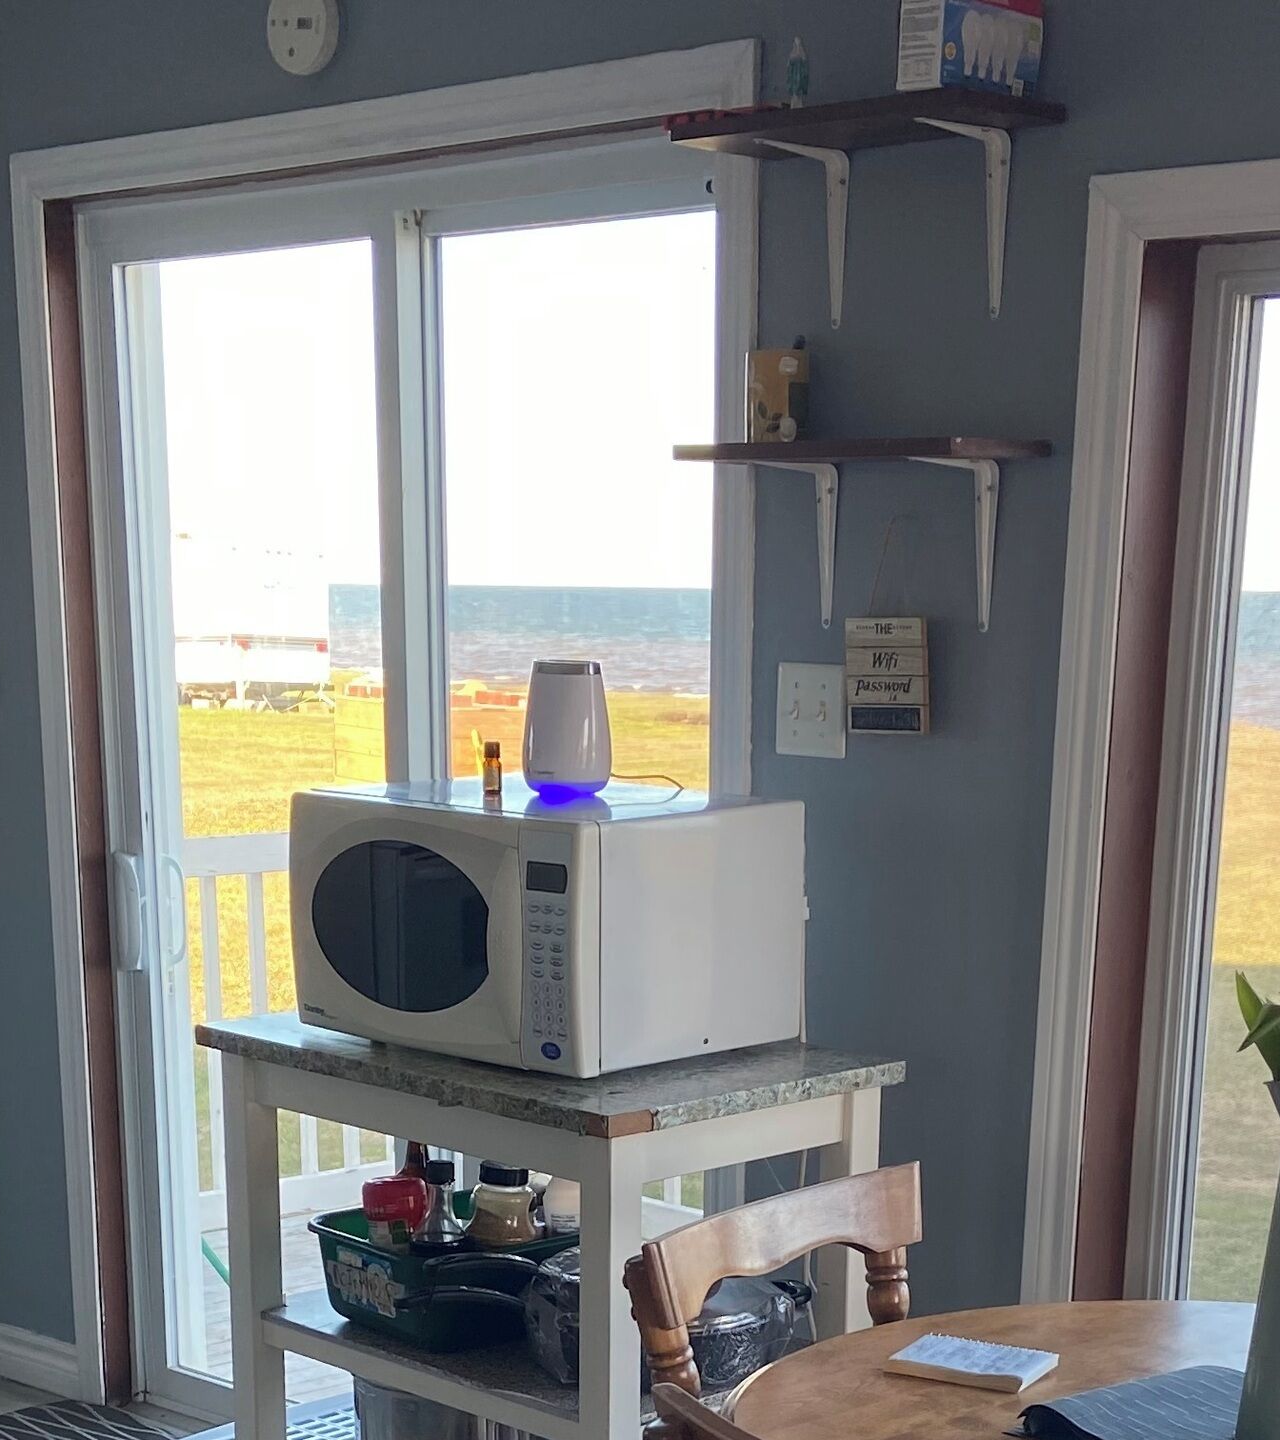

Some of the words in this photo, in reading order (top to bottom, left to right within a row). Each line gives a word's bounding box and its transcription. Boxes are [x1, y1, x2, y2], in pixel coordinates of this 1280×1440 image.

[874, 623, 894, 635] THE
[872, 652, 898, 671] Wifi
[855, 678, 913, 697] password
